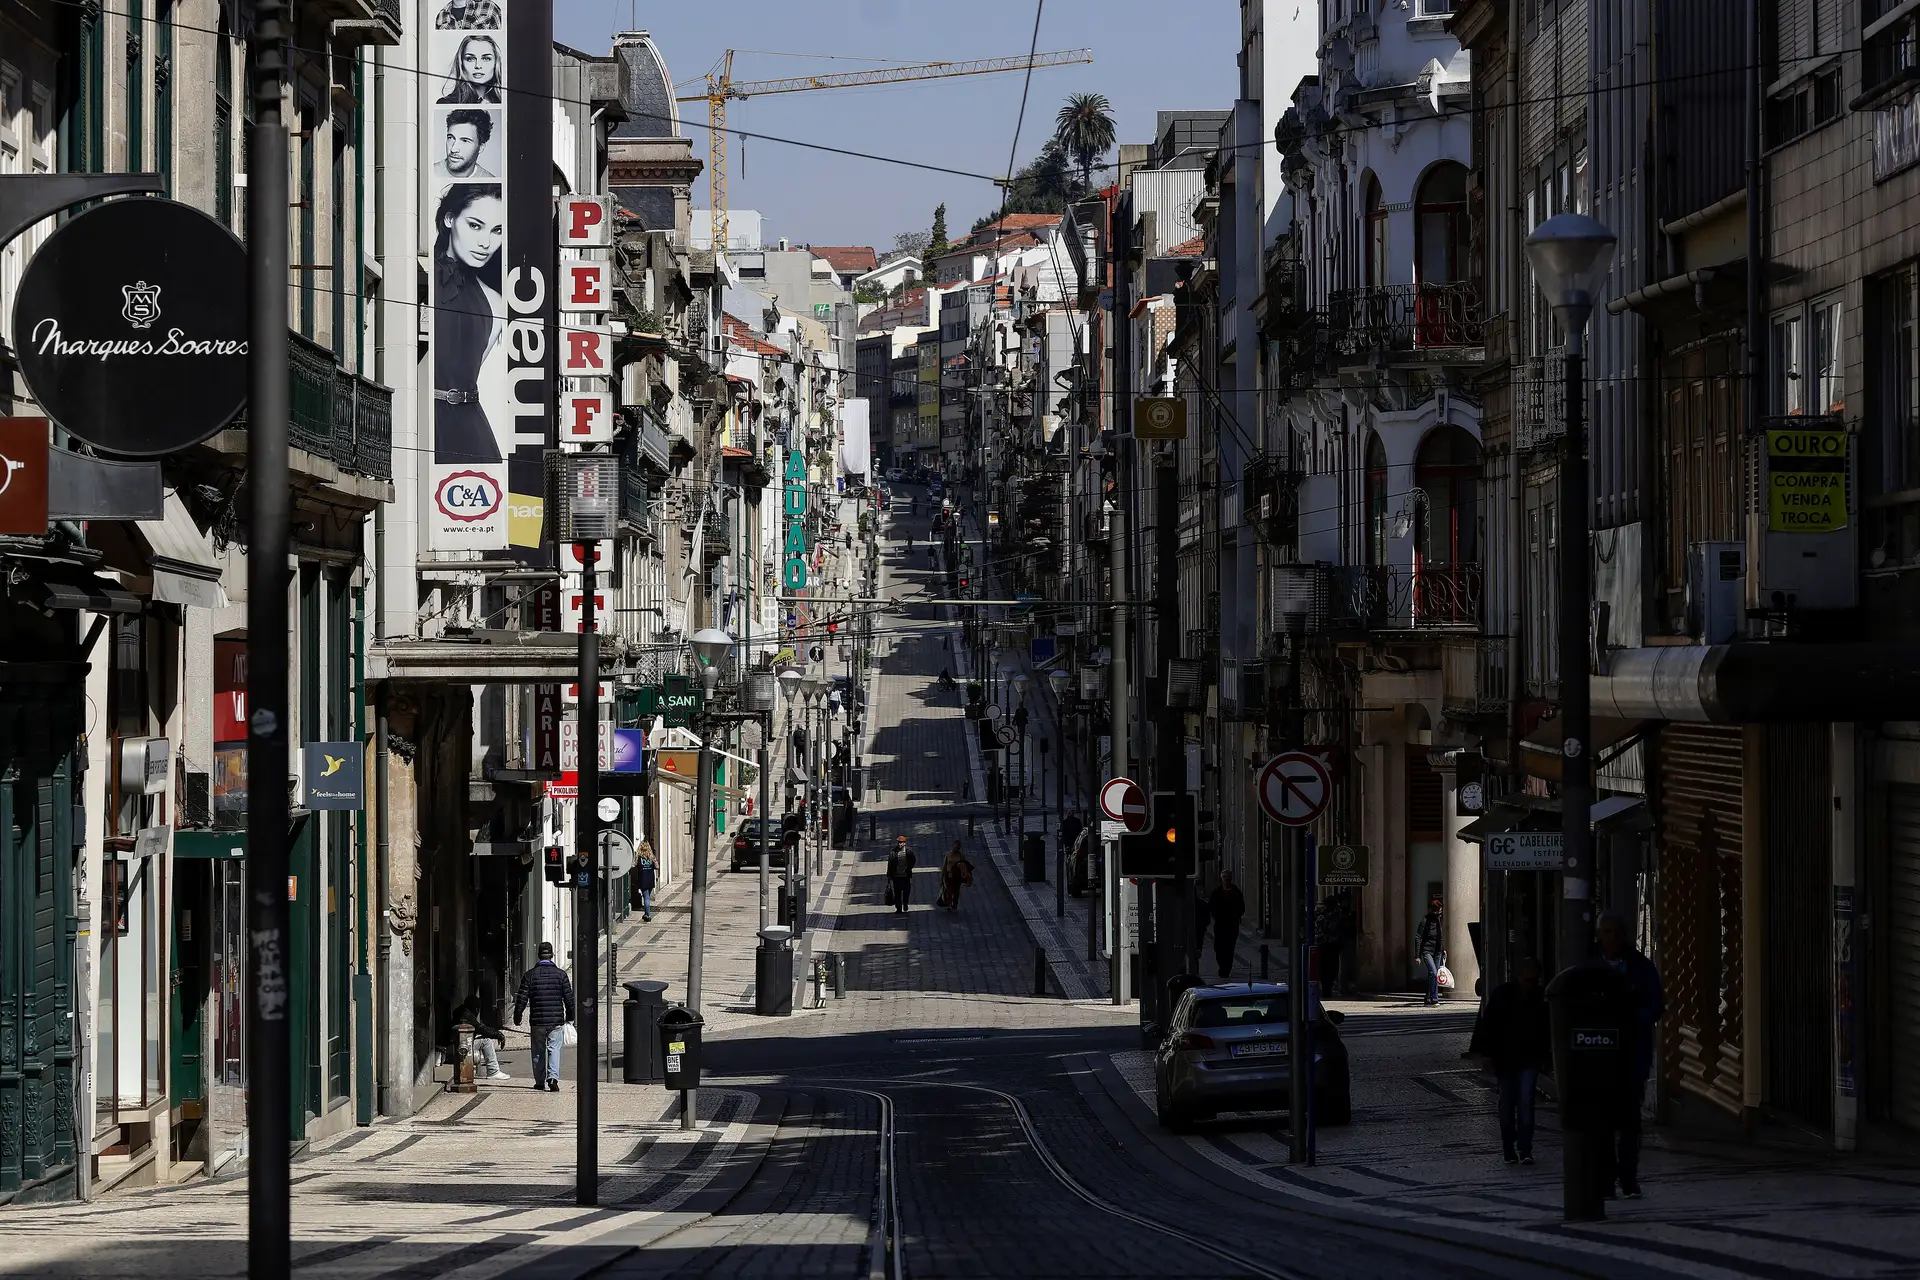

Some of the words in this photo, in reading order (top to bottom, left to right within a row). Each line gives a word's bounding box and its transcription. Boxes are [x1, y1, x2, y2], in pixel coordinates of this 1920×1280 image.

[32, 318, 154, 361] Marques
[153, 327, 249, 355] Soares
[1530, 393, 1544, 405] 661
[1530, 407, 1544, 419] 115
[1775, 435, 1840, 454] OURO
[1774, 475, 1840, 487] COMPRA
[447, 484, 491, 507] C&A
[1782, 494, 1832, 506] VENDA
[785, 450, 807, 589] ADÃO
[1781, 512, 1832, 524] TROCA
[1576, 1033, 1615, 1045] Porto.
